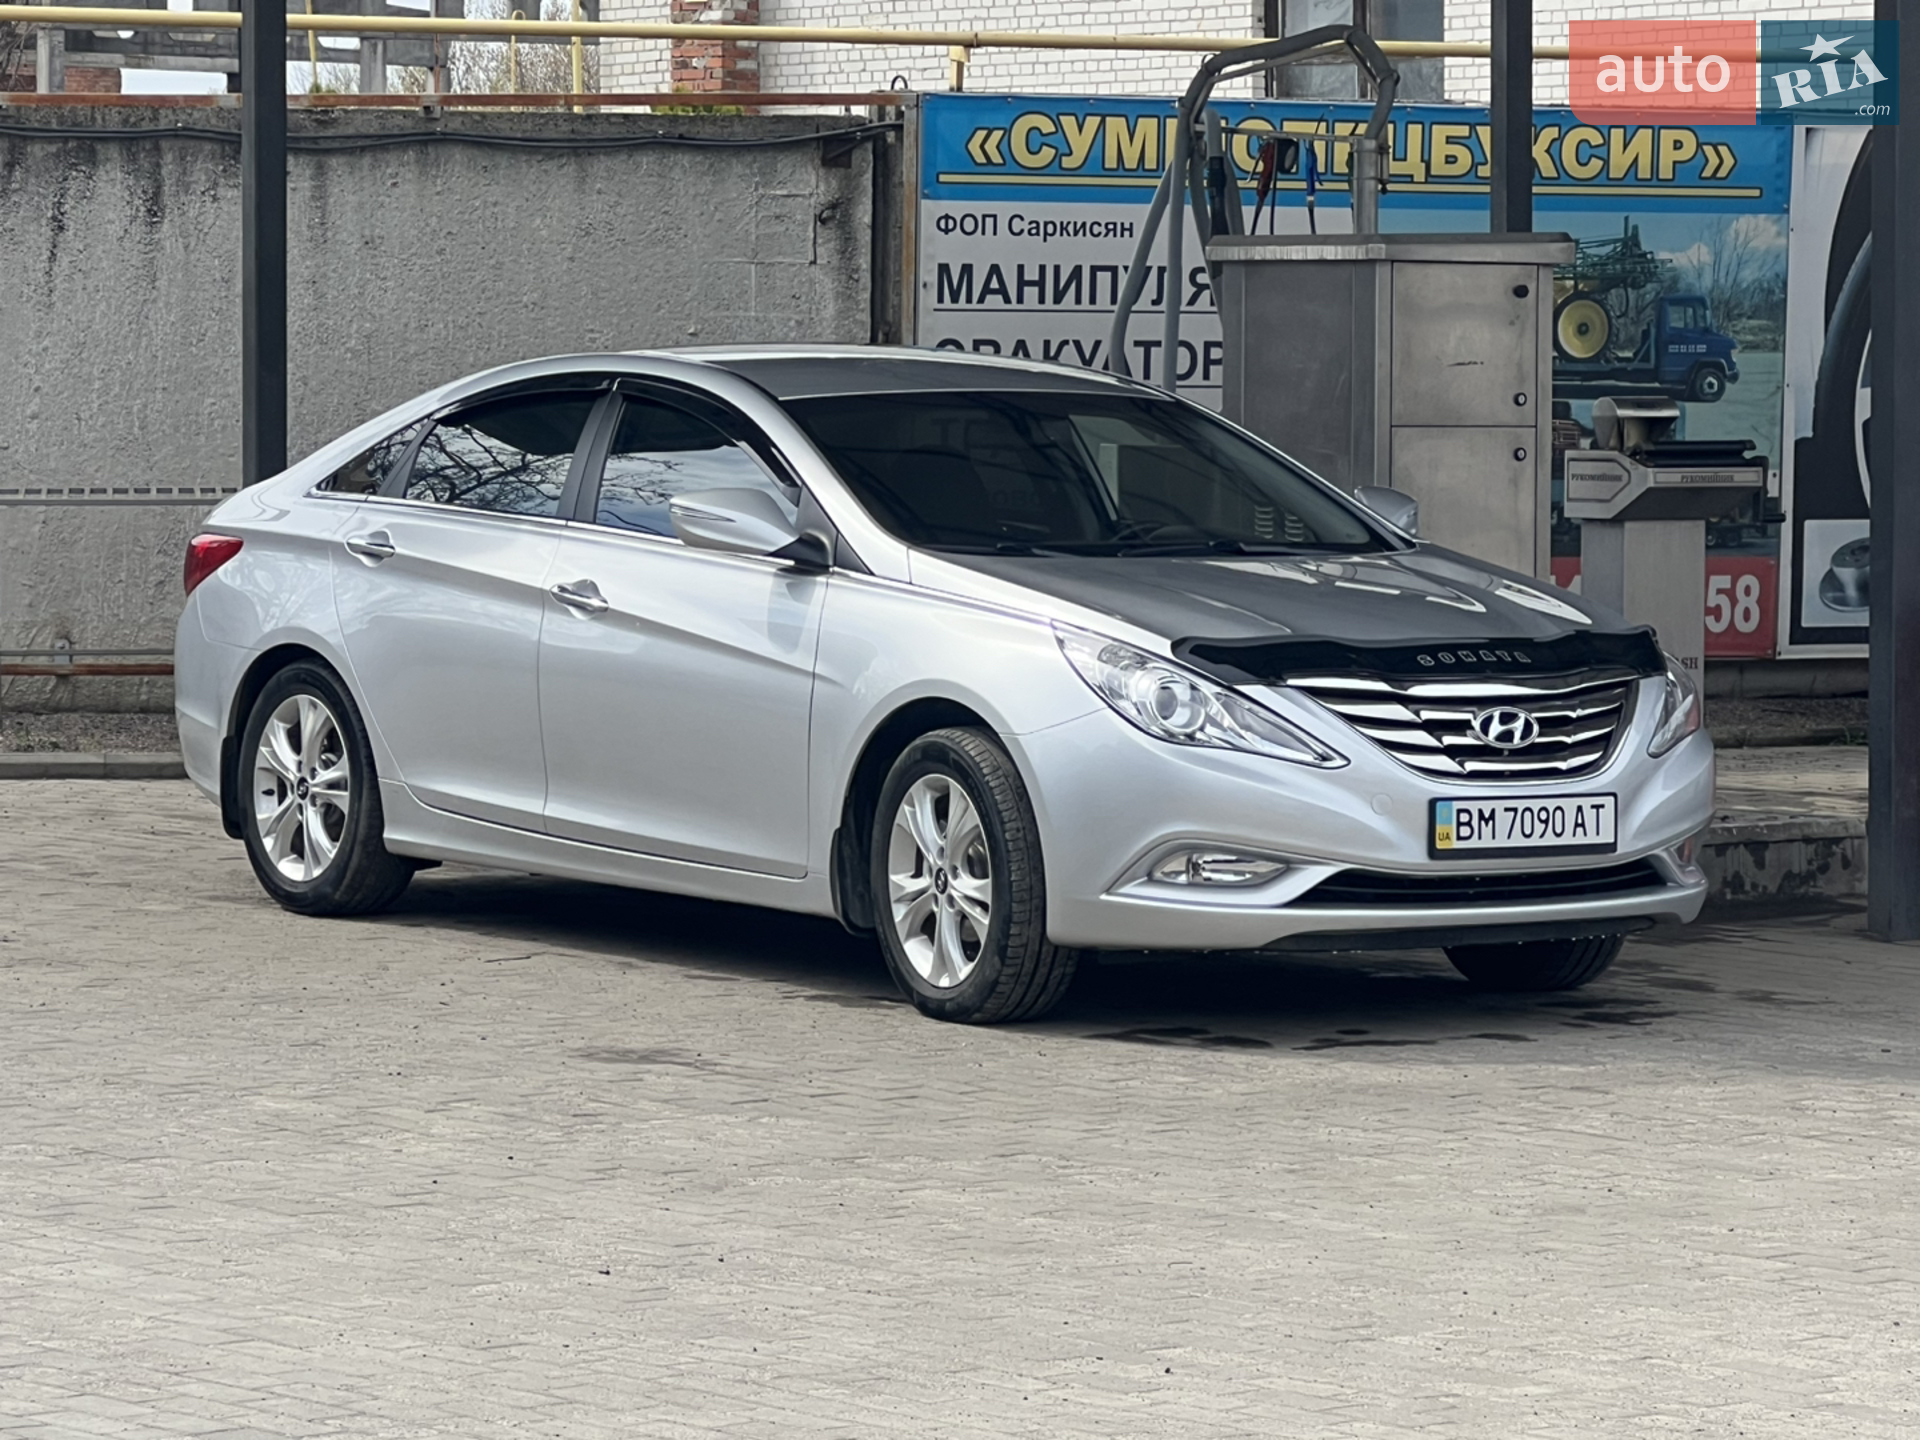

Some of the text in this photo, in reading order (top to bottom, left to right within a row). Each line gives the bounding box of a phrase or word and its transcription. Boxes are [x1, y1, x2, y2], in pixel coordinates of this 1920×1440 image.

[936, 213, 1134, 243] ФОП Саркисян
[1704, 574, 1761, 633] 58
[1438, 832, 1451, 841] UA
